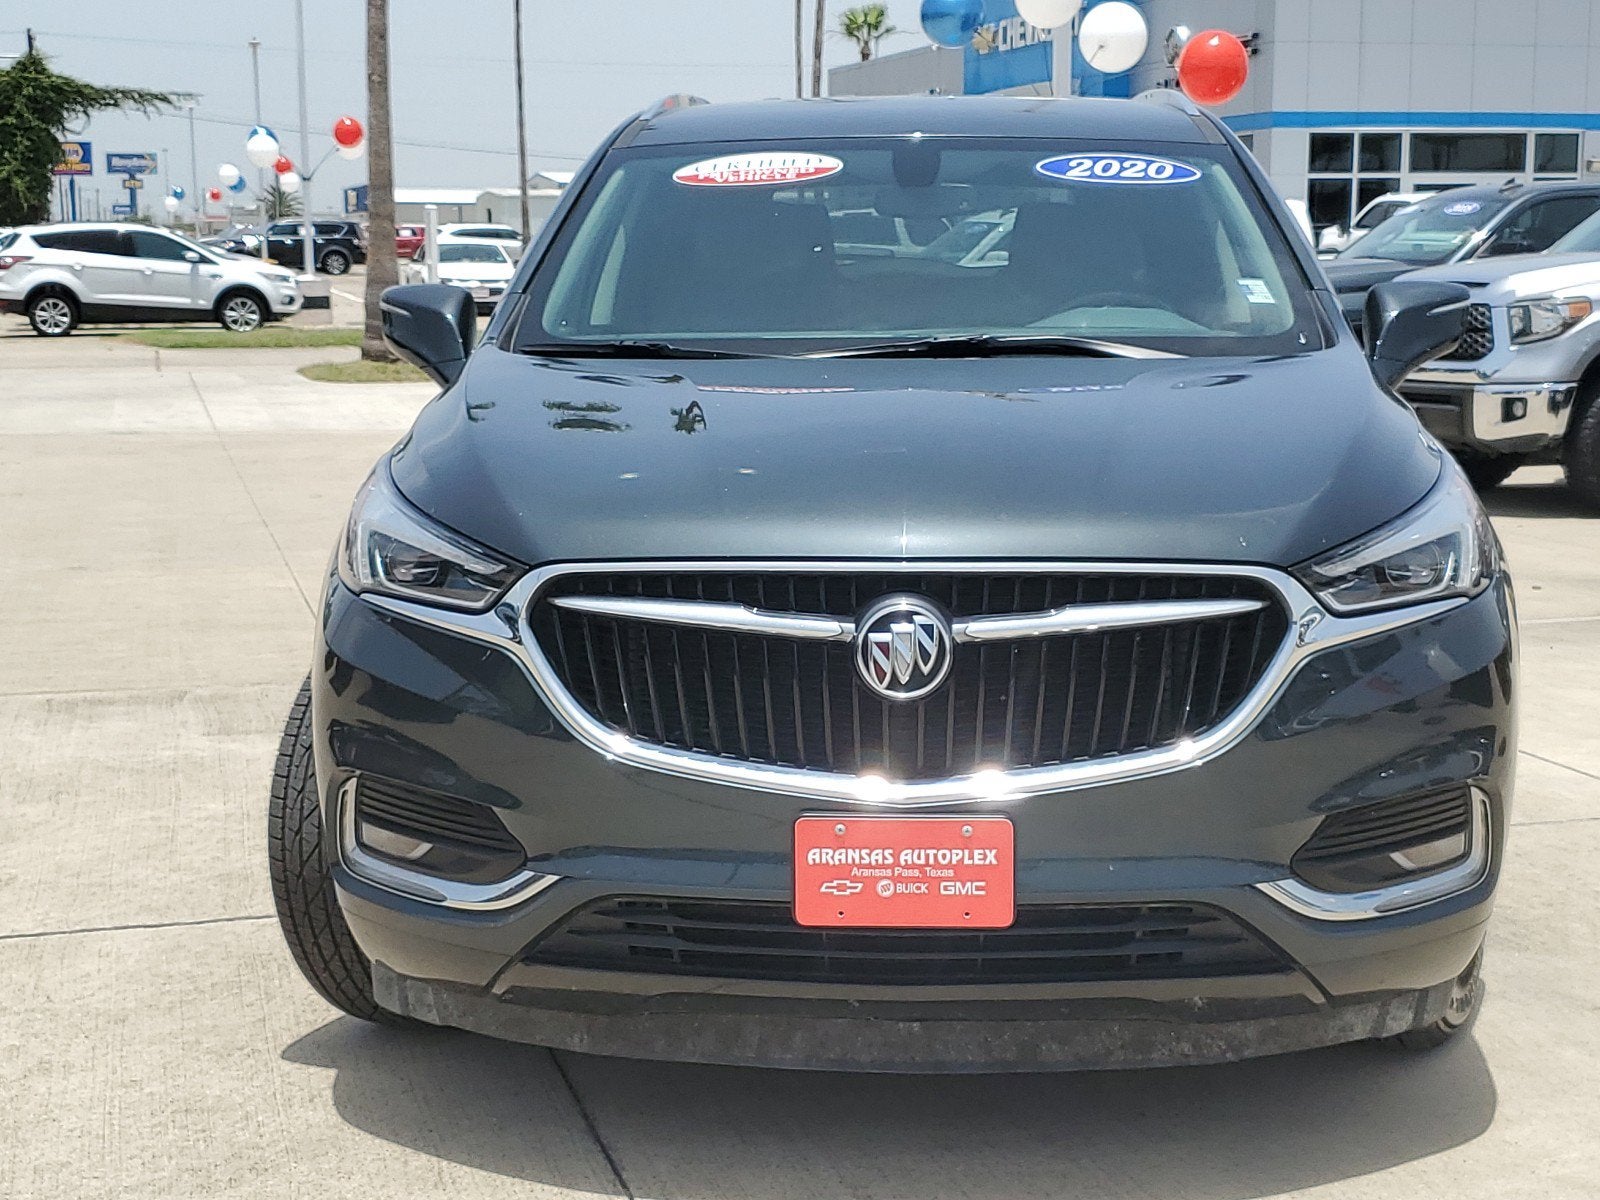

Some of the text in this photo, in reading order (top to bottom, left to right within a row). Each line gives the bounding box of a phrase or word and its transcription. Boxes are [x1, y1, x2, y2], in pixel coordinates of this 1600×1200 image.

[1065, 158, 1174, 179] 2020
[807, 848, 998, 866] ARANSAS AUTOPLEX
[851, 866, 954, 878] Aransas Pass, Texas
[896, 881, 986, 895] BUICK GMC
